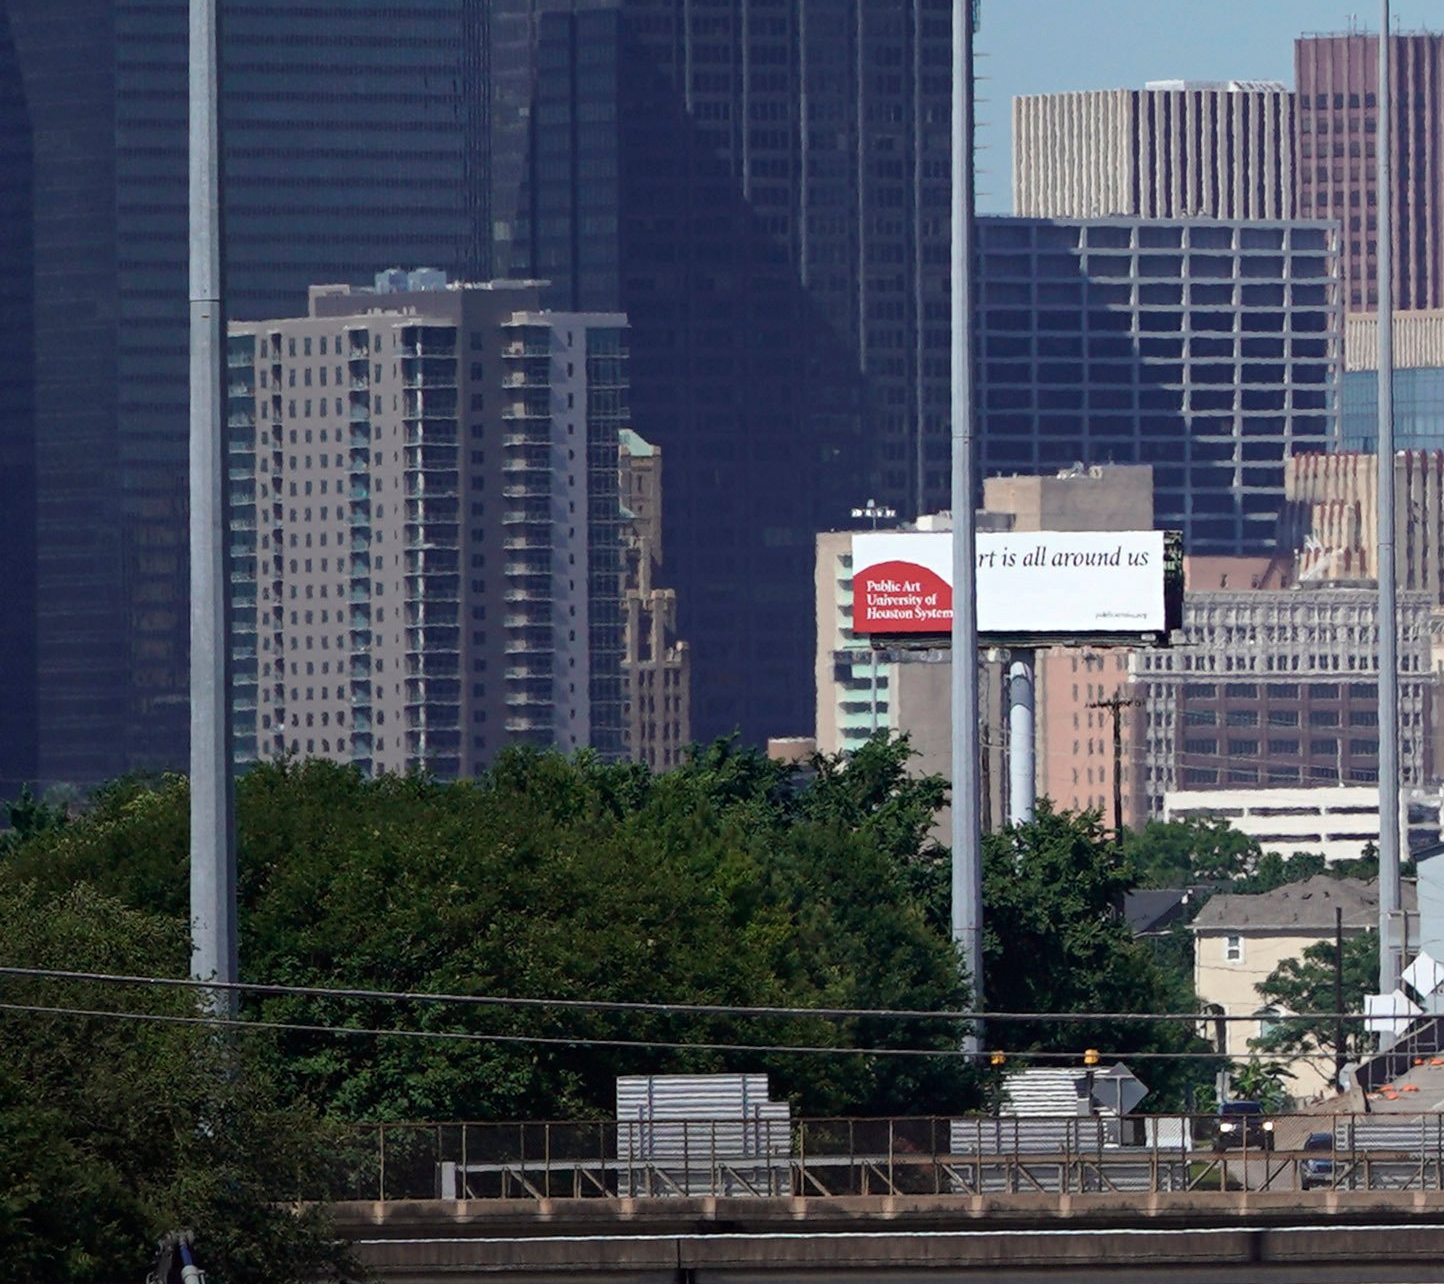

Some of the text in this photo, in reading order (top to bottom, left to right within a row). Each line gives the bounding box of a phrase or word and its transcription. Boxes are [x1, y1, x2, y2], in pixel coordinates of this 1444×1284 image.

[978, 546, 1149, 568] rt is all around us
[866, 579, 921, 592] Public Art
[866, 593, 938, 606] University of
[866, 605, 953, 621] Houston System
